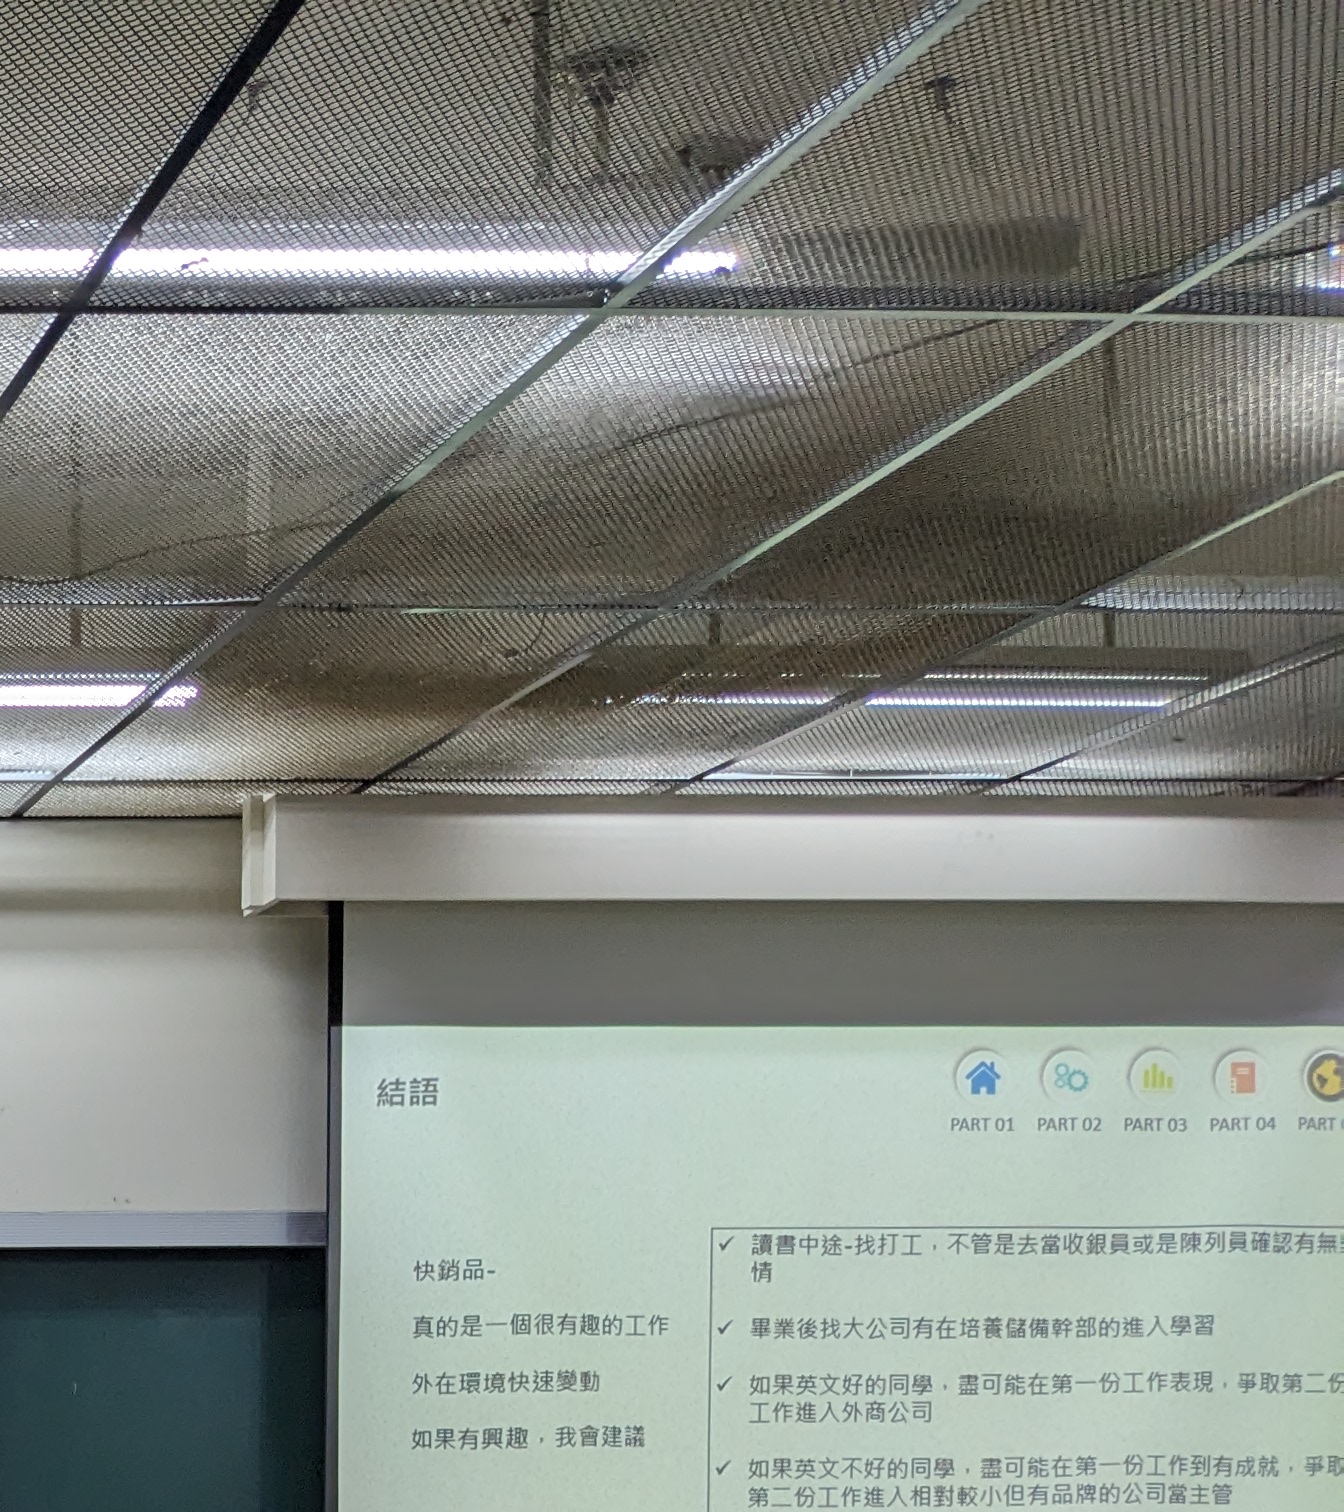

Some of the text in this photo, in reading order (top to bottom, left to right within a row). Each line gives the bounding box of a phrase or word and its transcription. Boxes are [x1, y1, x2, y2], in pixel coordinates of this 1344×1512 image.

[376, 1077, 440, 1108] 結語
[950, 1116, 1015, 1132] PART 01
[1037, 1116, 1102, 1132] PART 02
[1123, 1117, 1188, 1133] PART 03
[1209, 1116, 1277, 1132] PART 04
[1297, 1116, 1337, 1132] PART
[751, 1230, 1344, 1257] 讀書中途-找打工，不管是去當收銀員或是陳列員確認有無
[412, 1258, 496, 1282] 快銷品-
[750, 1260, 773, 1284] 情
[412, 1312, 670, 1340] 真的是一個很有趣的工作
[411, 1368, 600, 1396] 外在環境快速變動
[748, 1400, 933, 1424] 工作進入外商公司
